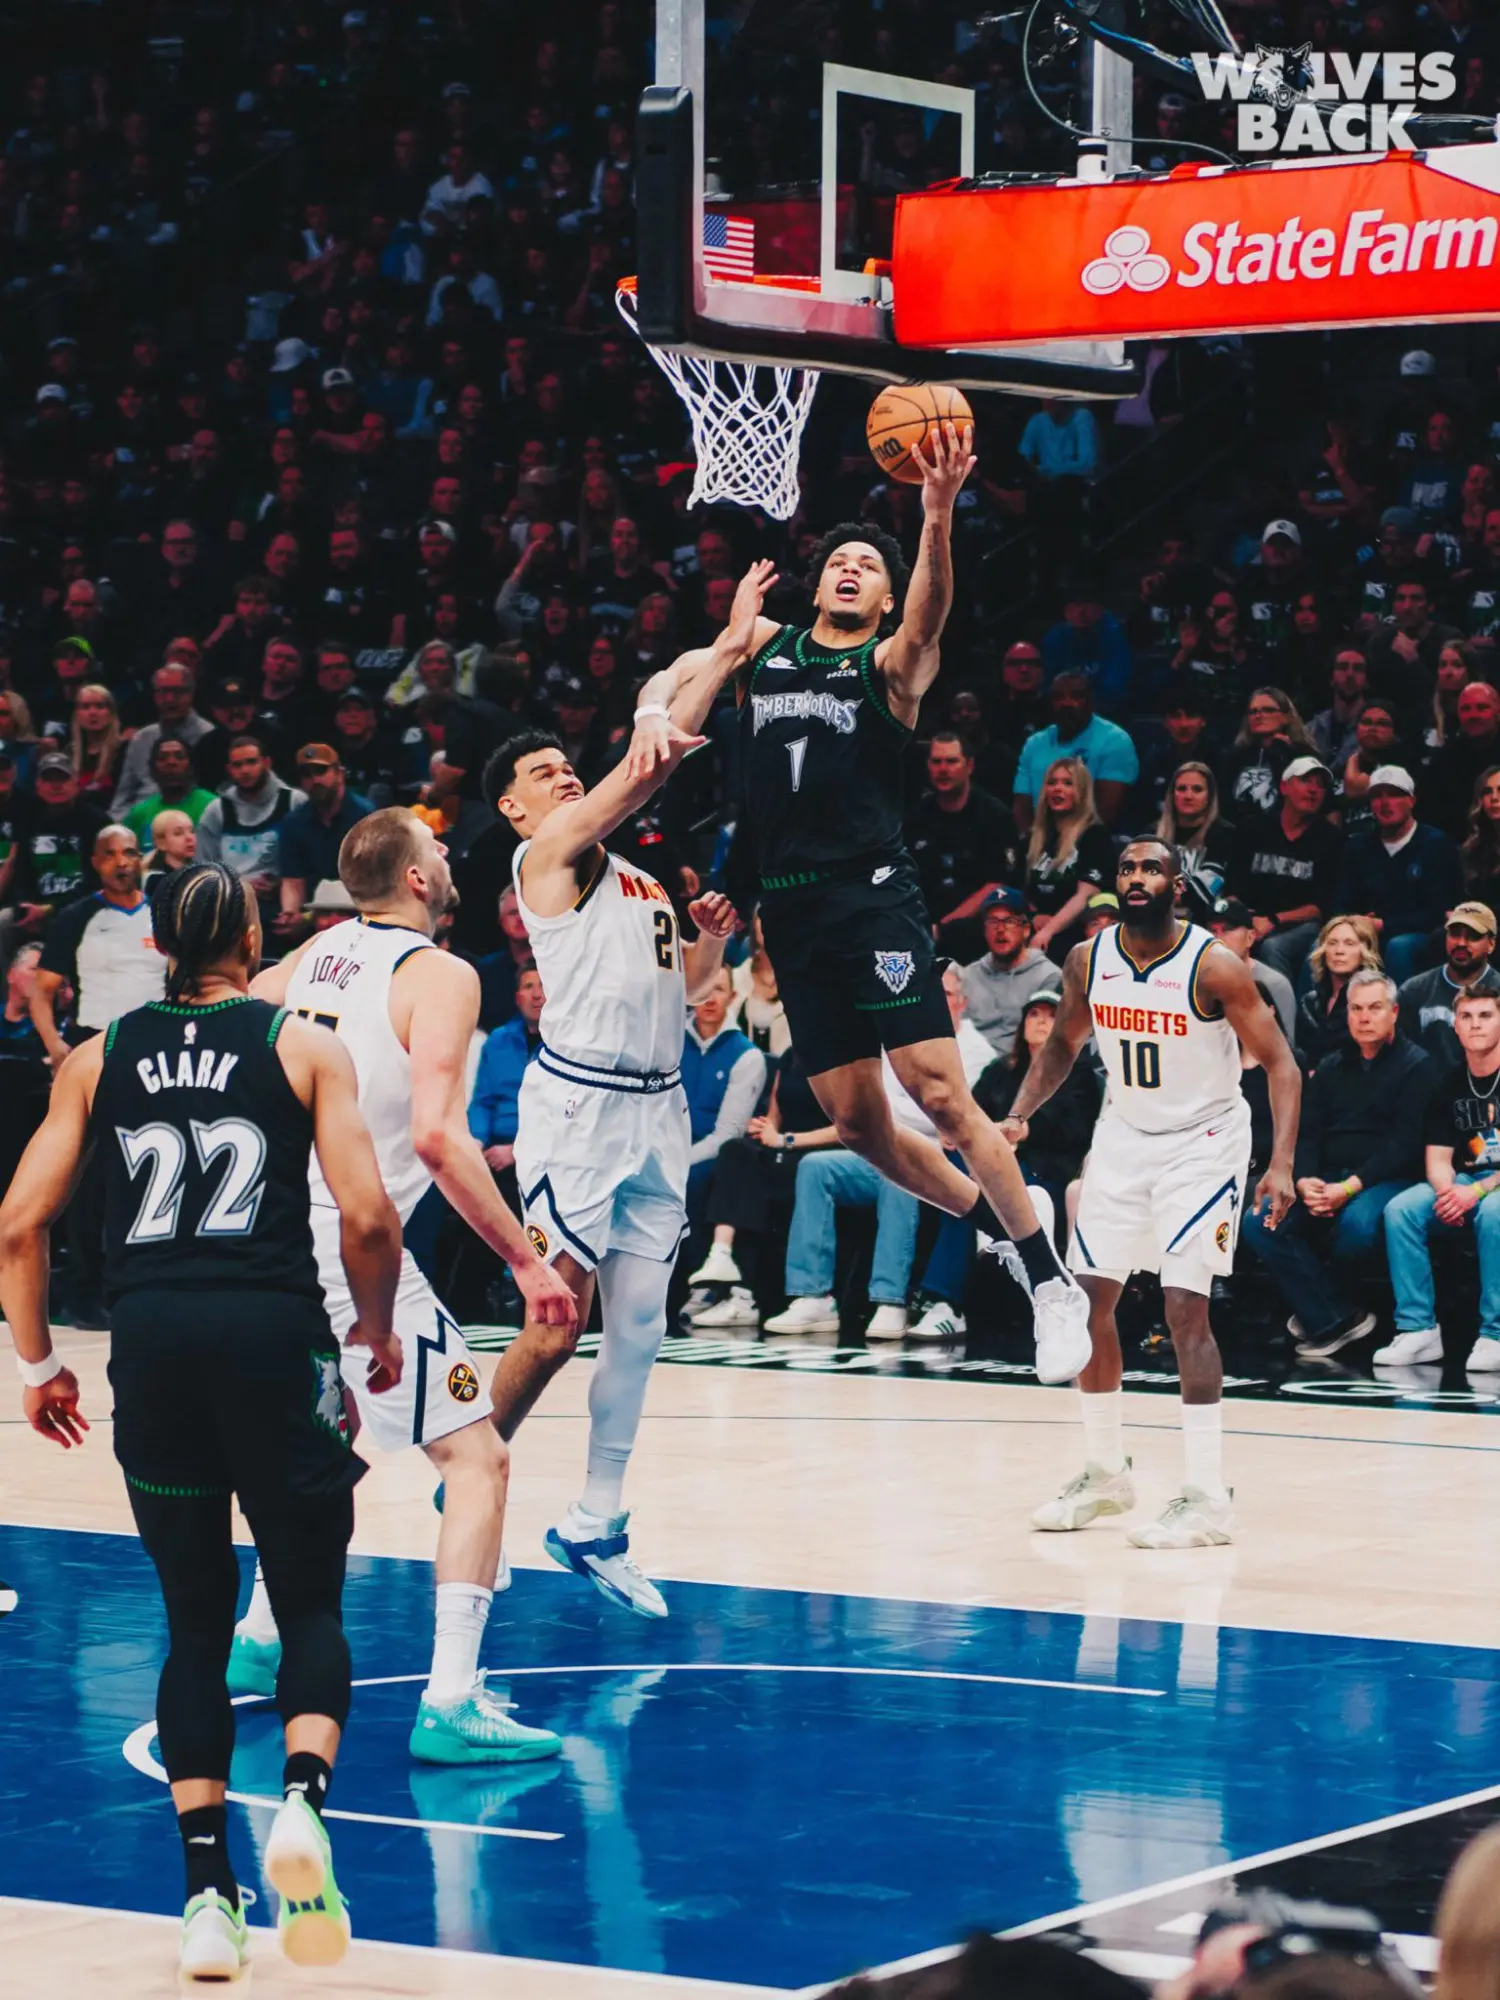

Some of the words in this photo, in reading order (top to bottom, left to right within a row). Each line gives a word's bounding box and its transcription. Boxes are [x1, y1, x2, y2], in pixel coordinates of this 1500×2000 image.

[750, 689, 864, 737] TIMBERWOLVES
[784, 736, 808, 792] 1
[1093, 1002, 1188, 1037] NUGGETS
[136, 1048, 240, 1095] CLARK
[1118, 1037, 1163, 1090] 10
[114, 1115, 269, 1245] 22
